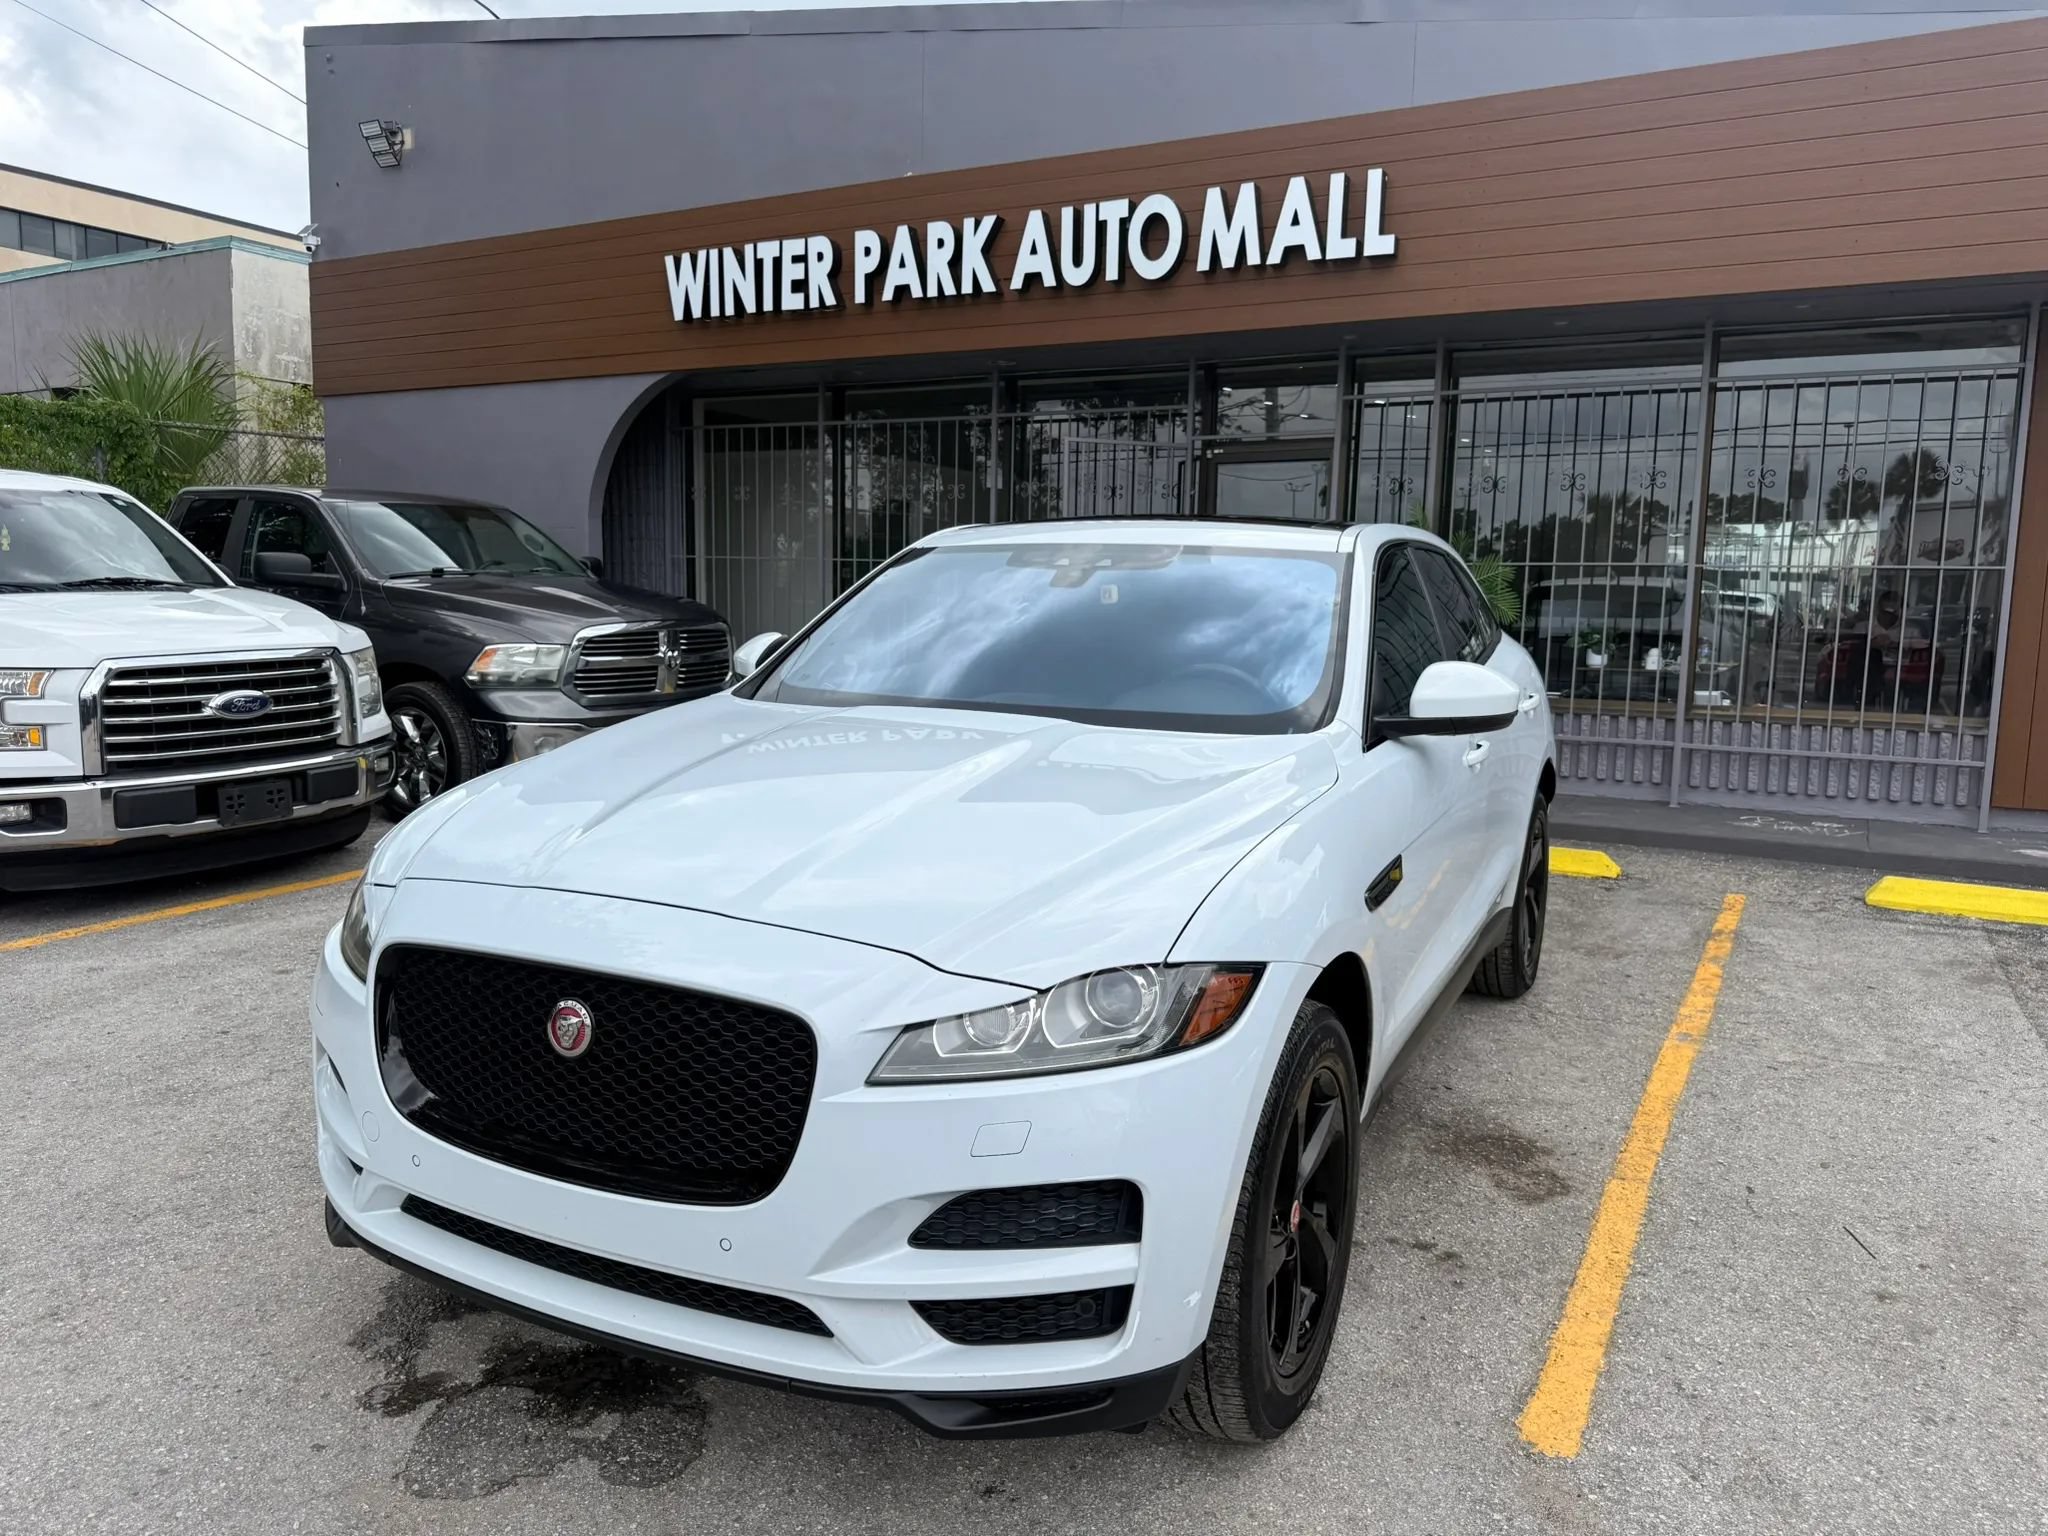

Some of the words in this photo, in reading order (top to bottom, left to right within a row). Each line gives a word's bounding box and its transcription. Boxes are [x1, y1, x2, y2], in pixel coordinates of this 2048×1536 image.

[664, 235, 837, 322] WINTER
[854, 214, 1002, 304] PARK
[1009, 193, 1183, 291] AUTO
[1195, 167, 1397, 272] MALL
[231, 697, 261, 712] Ford
